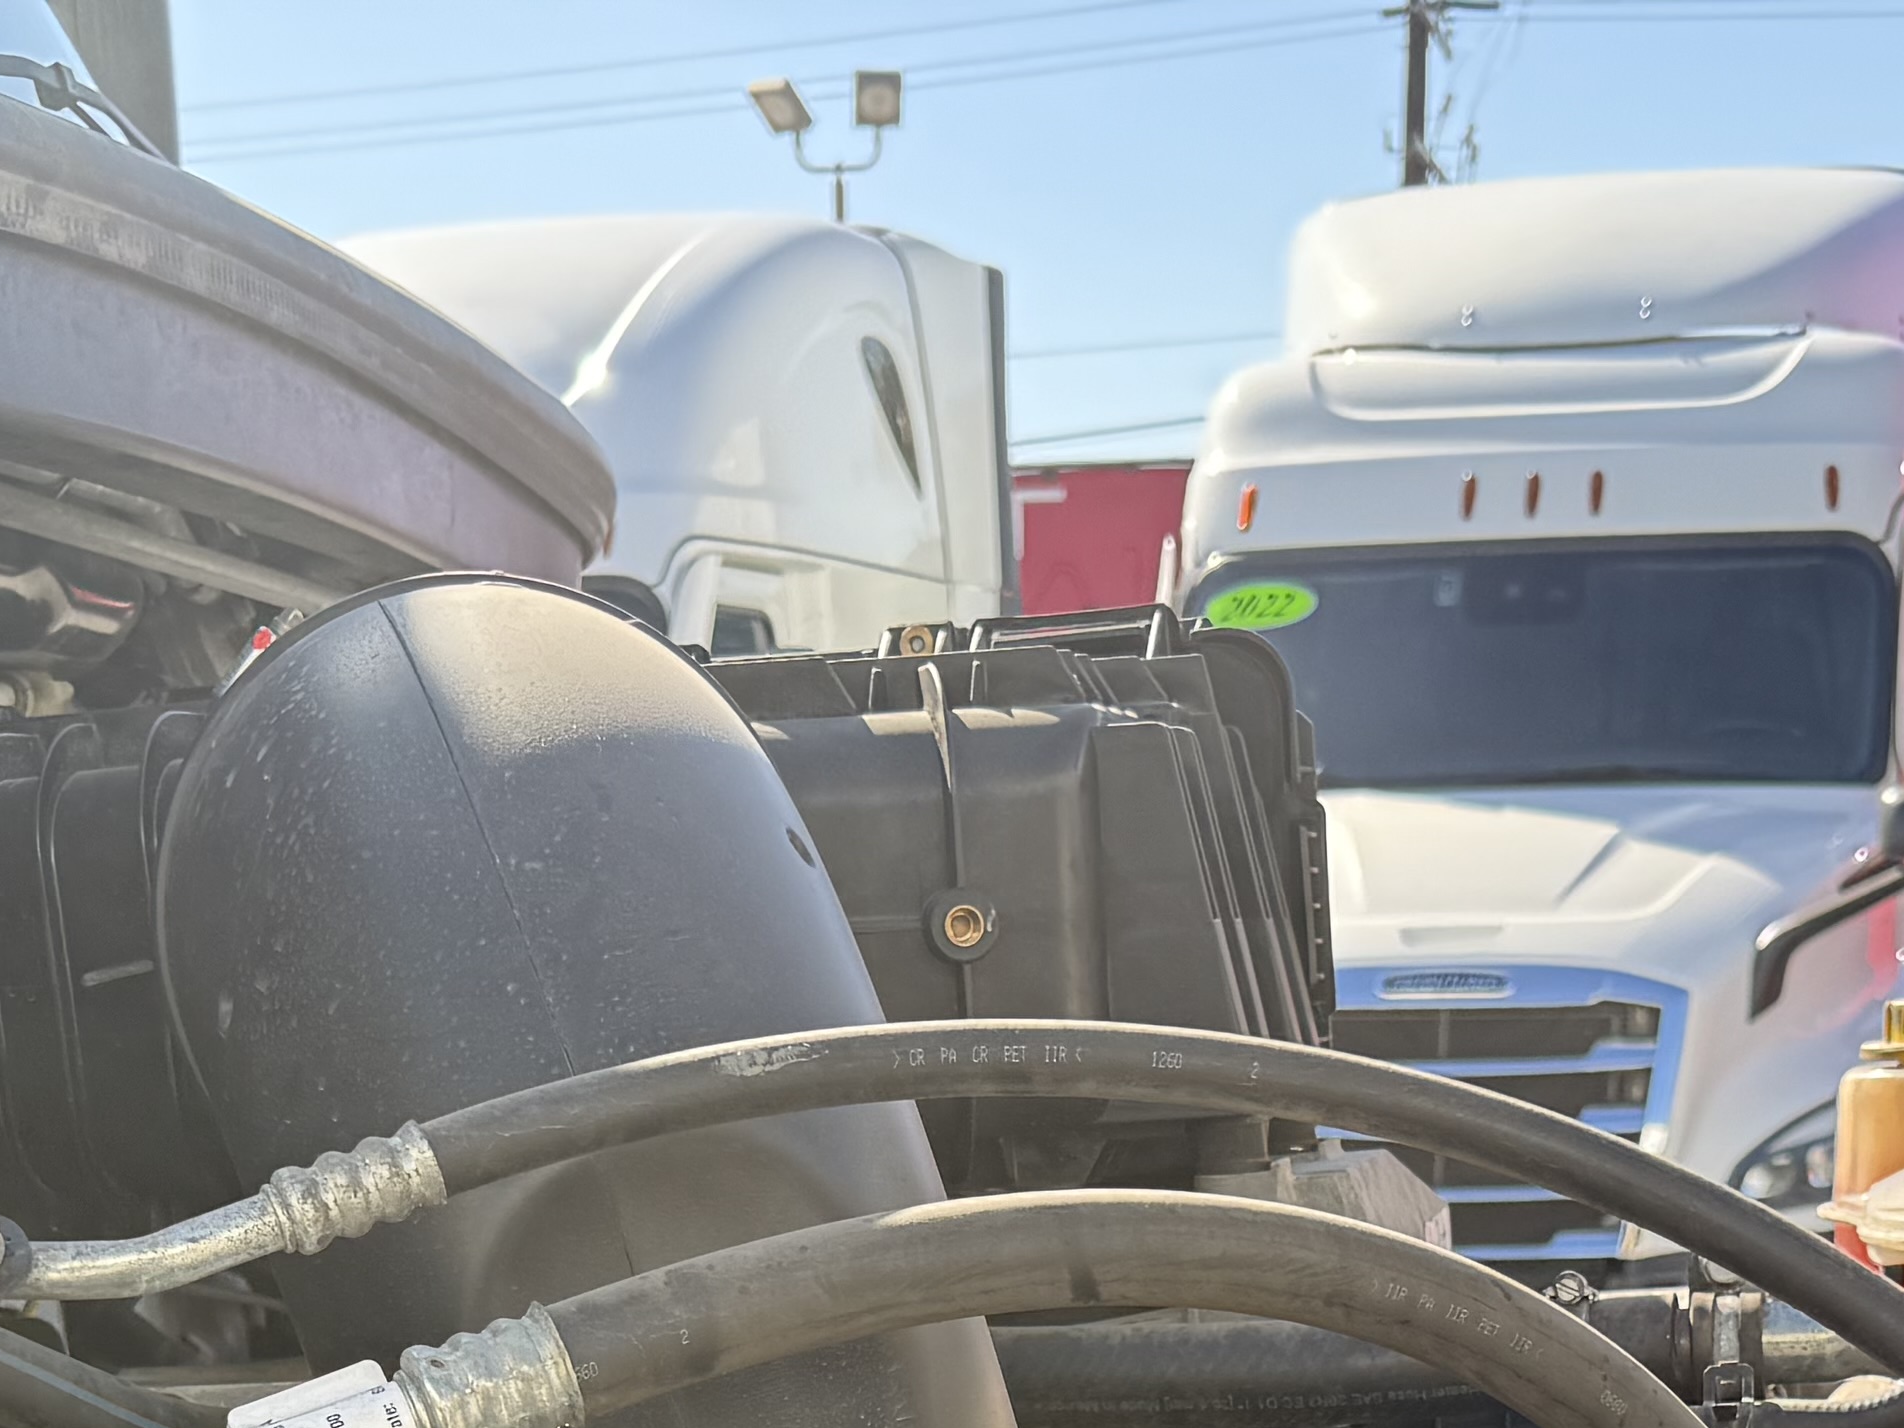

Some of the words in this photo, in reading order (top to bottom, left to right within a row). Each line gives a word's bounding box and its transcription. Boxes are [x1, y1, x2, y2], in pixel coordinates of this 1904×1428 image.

[1221, 592, 1296, 622] 2022
[940, 1047, 957, 1064] PA
[1003, 1045, 1026, 1063] PET
